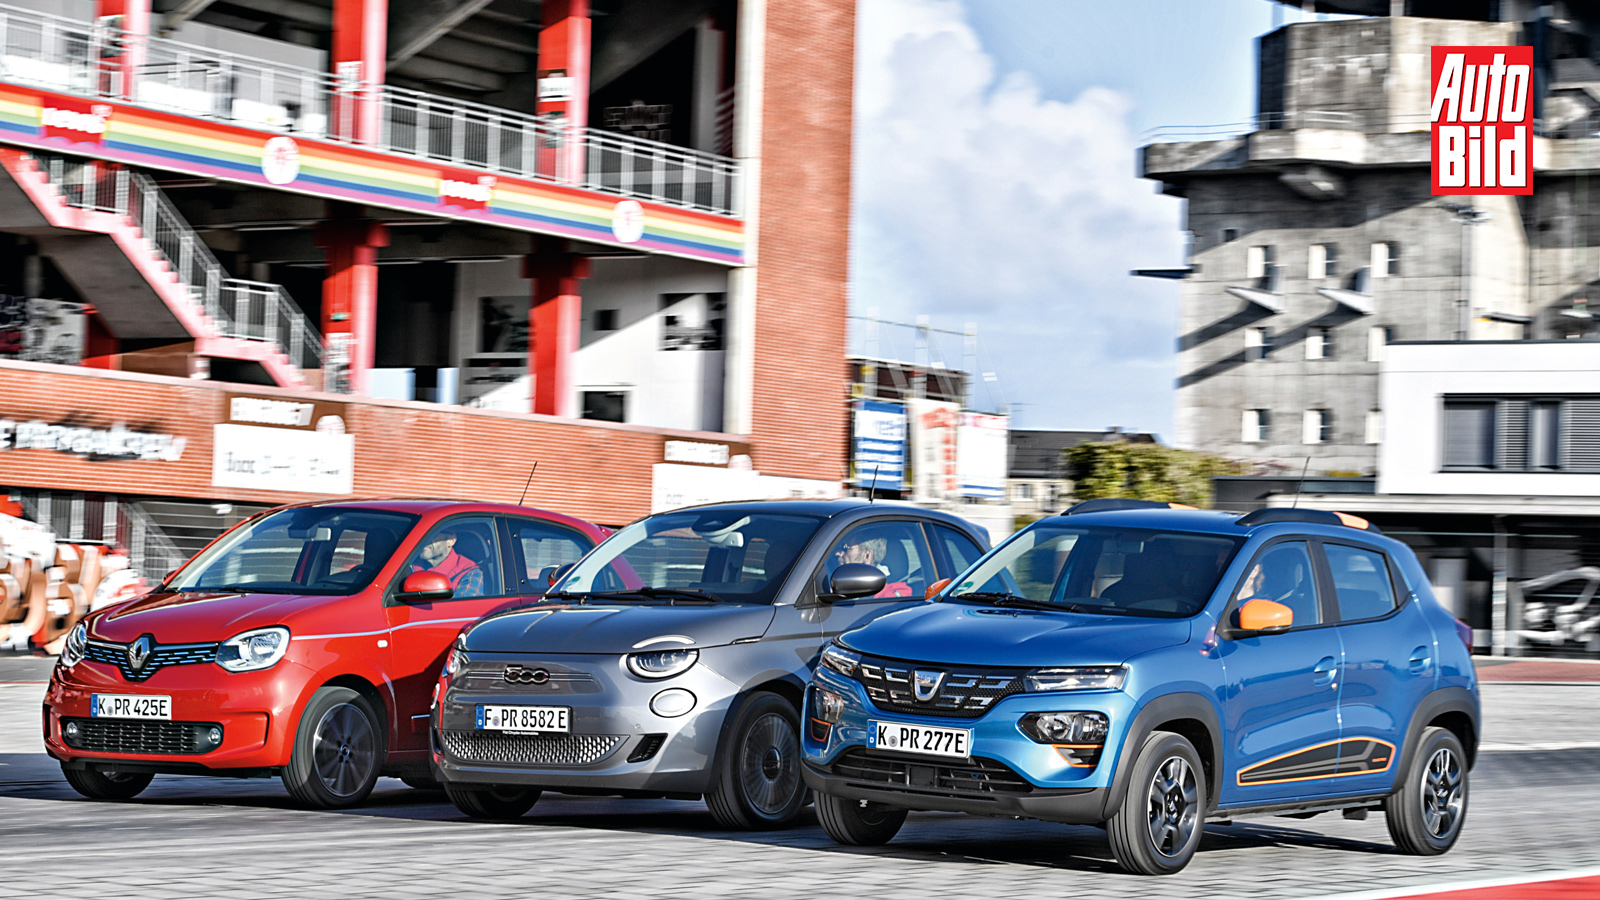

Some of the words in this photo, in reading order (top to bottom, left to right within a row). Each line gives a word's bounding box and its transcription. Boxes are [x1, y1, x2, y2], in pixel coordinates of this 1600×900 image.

[505, 665, 549, 684] 500
[98, 698, 105, 714] K
[115, 698, 130, 715] PR
[134, 699, 168, 716] 425E
[485, 709, 492, 726] F
[501, 709, 518, 727] PR
[878, 725, 887, 746] K
[900, 727, 919, 749] PR
[923, 730, 965, 754] 277E
